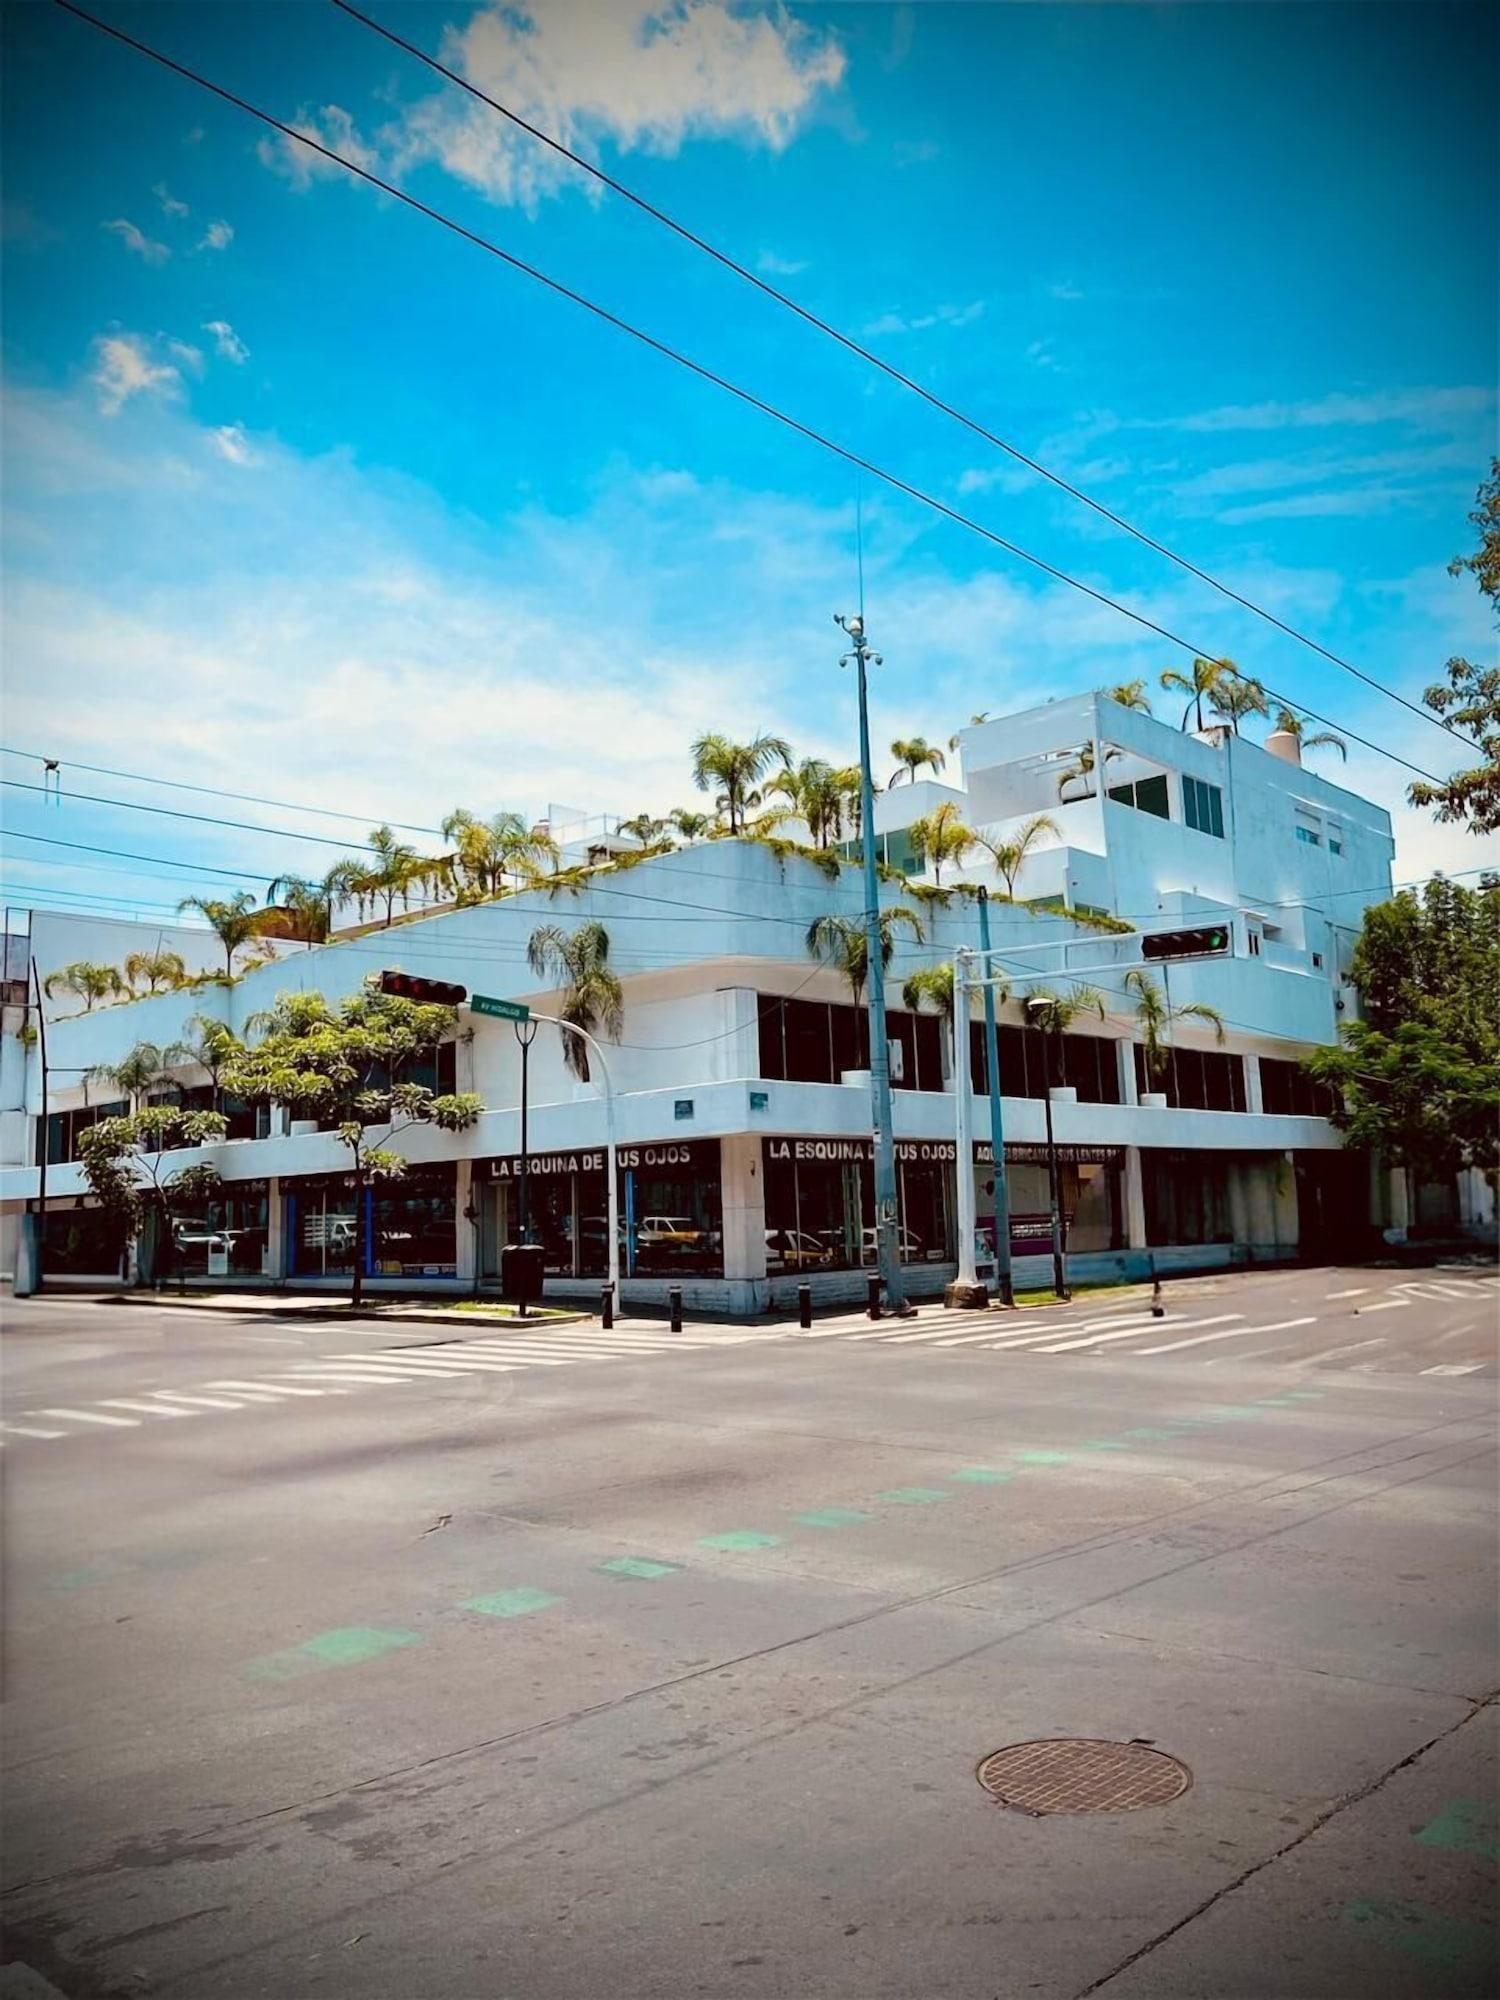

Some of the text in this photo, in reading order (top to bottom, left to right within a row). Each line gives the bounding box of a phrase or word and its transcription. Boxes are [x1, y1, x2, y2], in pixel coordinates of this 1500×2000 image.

[491, 1160, 509, 1177] LA
[582, 1153, 603, 1171] DE
[618, 1150, 640, 1168] US
[644, 1145, 690, 1166] OJOS
[769, 1140, 791, 1159] LA
[795, 1141, 864, 1160] ESQUINA
[921, 1144, 956, 1159] OJOS
